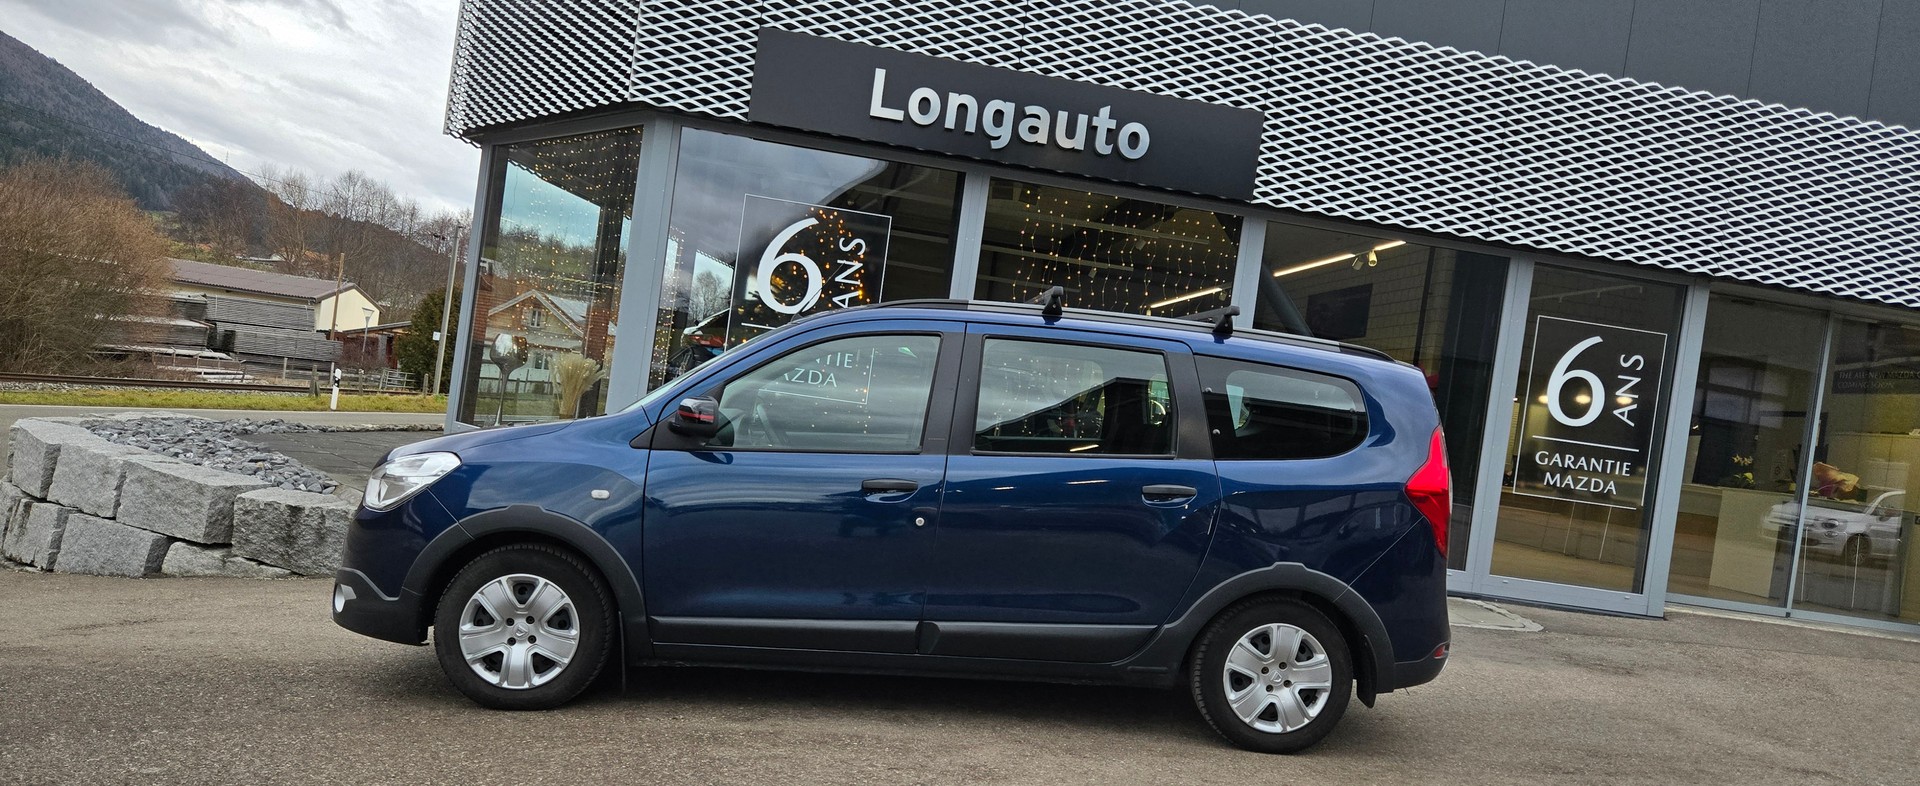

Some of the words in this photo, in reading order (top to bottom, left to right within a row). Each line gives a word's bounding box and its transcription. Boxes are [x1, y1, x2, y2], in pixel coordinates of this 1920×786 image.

[869, 67, 1150, 160] Longauto
[757, 217, 822, 315] 6
[832, 237, 866, 309] ANS
[1547, 335, 1606, 427] 6
[1612, 353, 1645, 427] ANS
[1535, 450, 1632, 477] GARANTIE
[1543, 472, 1617, 496] MAZDA
